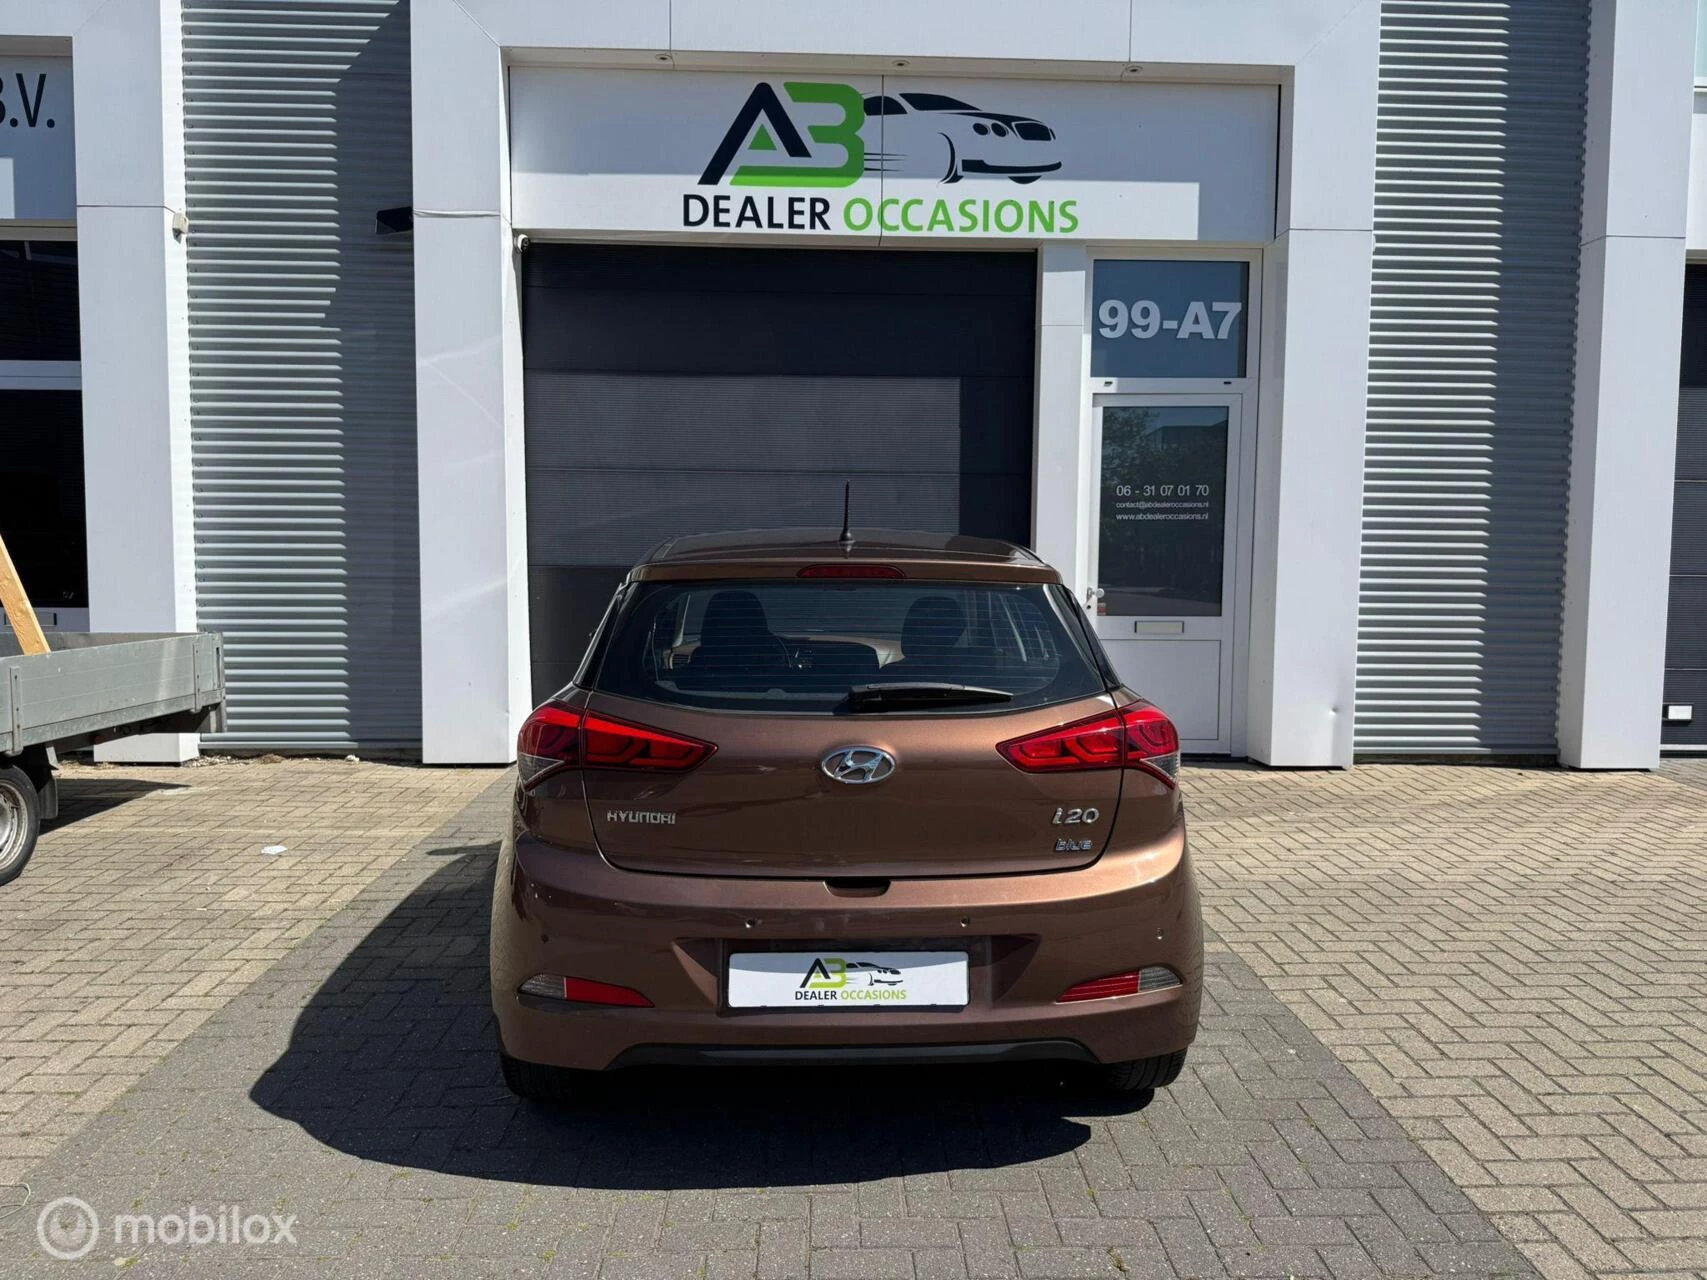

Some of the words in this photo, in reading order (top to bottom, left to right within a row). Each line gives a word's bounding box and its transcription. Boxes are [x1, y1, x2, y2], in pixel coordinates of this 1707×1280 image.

[0, 73, 55, 128] .V.
[697, 82, 865, 188] AB
[682, 194, 831, 231] DEALER
[843, 198, 1079, 233] OCCASIONS
[1098, 299, 1242, 339] 99-A7
[1116, 485, 1131, 496] 06
[1143, 485, 1155, 496] 31
[1160, 485, 1174, 496] 07
[1178, 485, 1190, 496] 01
[1195, 485, 1209, 496] 70
[1116, 501, 1209, 509] contact@abdealeroccasions.nl
[1116, 512, 1209, 520] www.abdealeroccasions.nl
[606, 810, 676, 825] HYUNDAI
[1052, 807, 1100, 825] i20
[795, 990, 838, 1001] DEALER
[841, 989, 907, 1000] OCCASIONS
